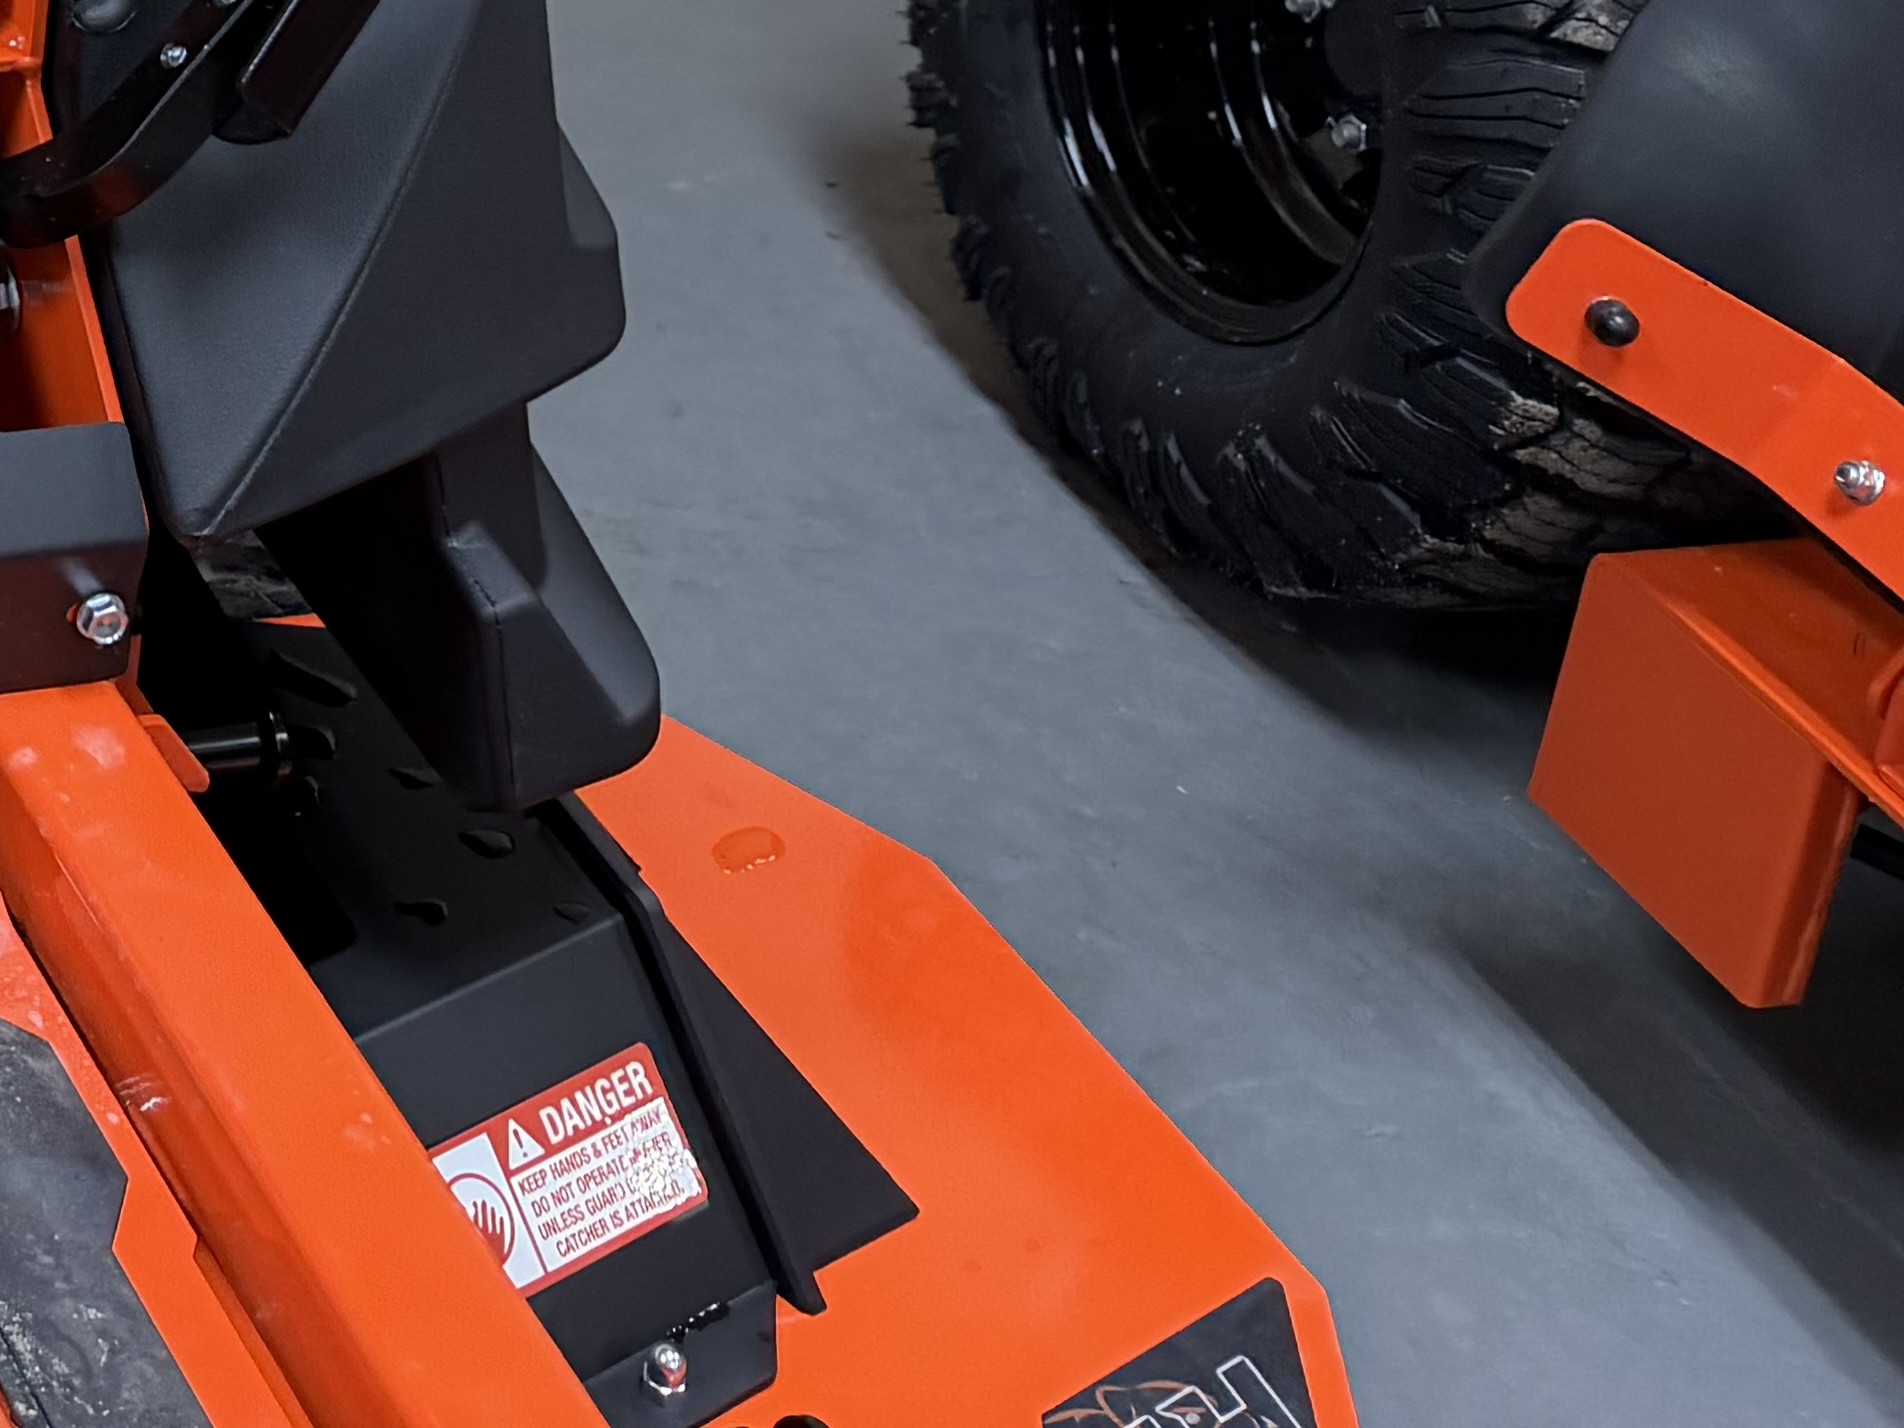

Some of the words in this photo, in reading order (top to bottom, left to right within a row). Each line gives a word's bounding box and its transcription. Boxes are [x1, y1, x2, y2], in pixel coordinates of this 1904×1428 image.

[539, 1060, 654, 1145] DANGER
[518, 1168, 548, 1197] KEEP
[550, 1147, 592, 1180] HANDS
[591, 1142, 603, 1159] &
[602, 1126, 630, 1153] FEET
[531, 1196, 549, 1217] DO
[551, 1182, 577, 1208] NOT
[576, 1158, 630, 1193] OPERATE
[538, 1209, 585, 1240] UNLESS
[555, 1220, 611, 1258] CATCHER
[612, 1211, 625, 1230] IS
